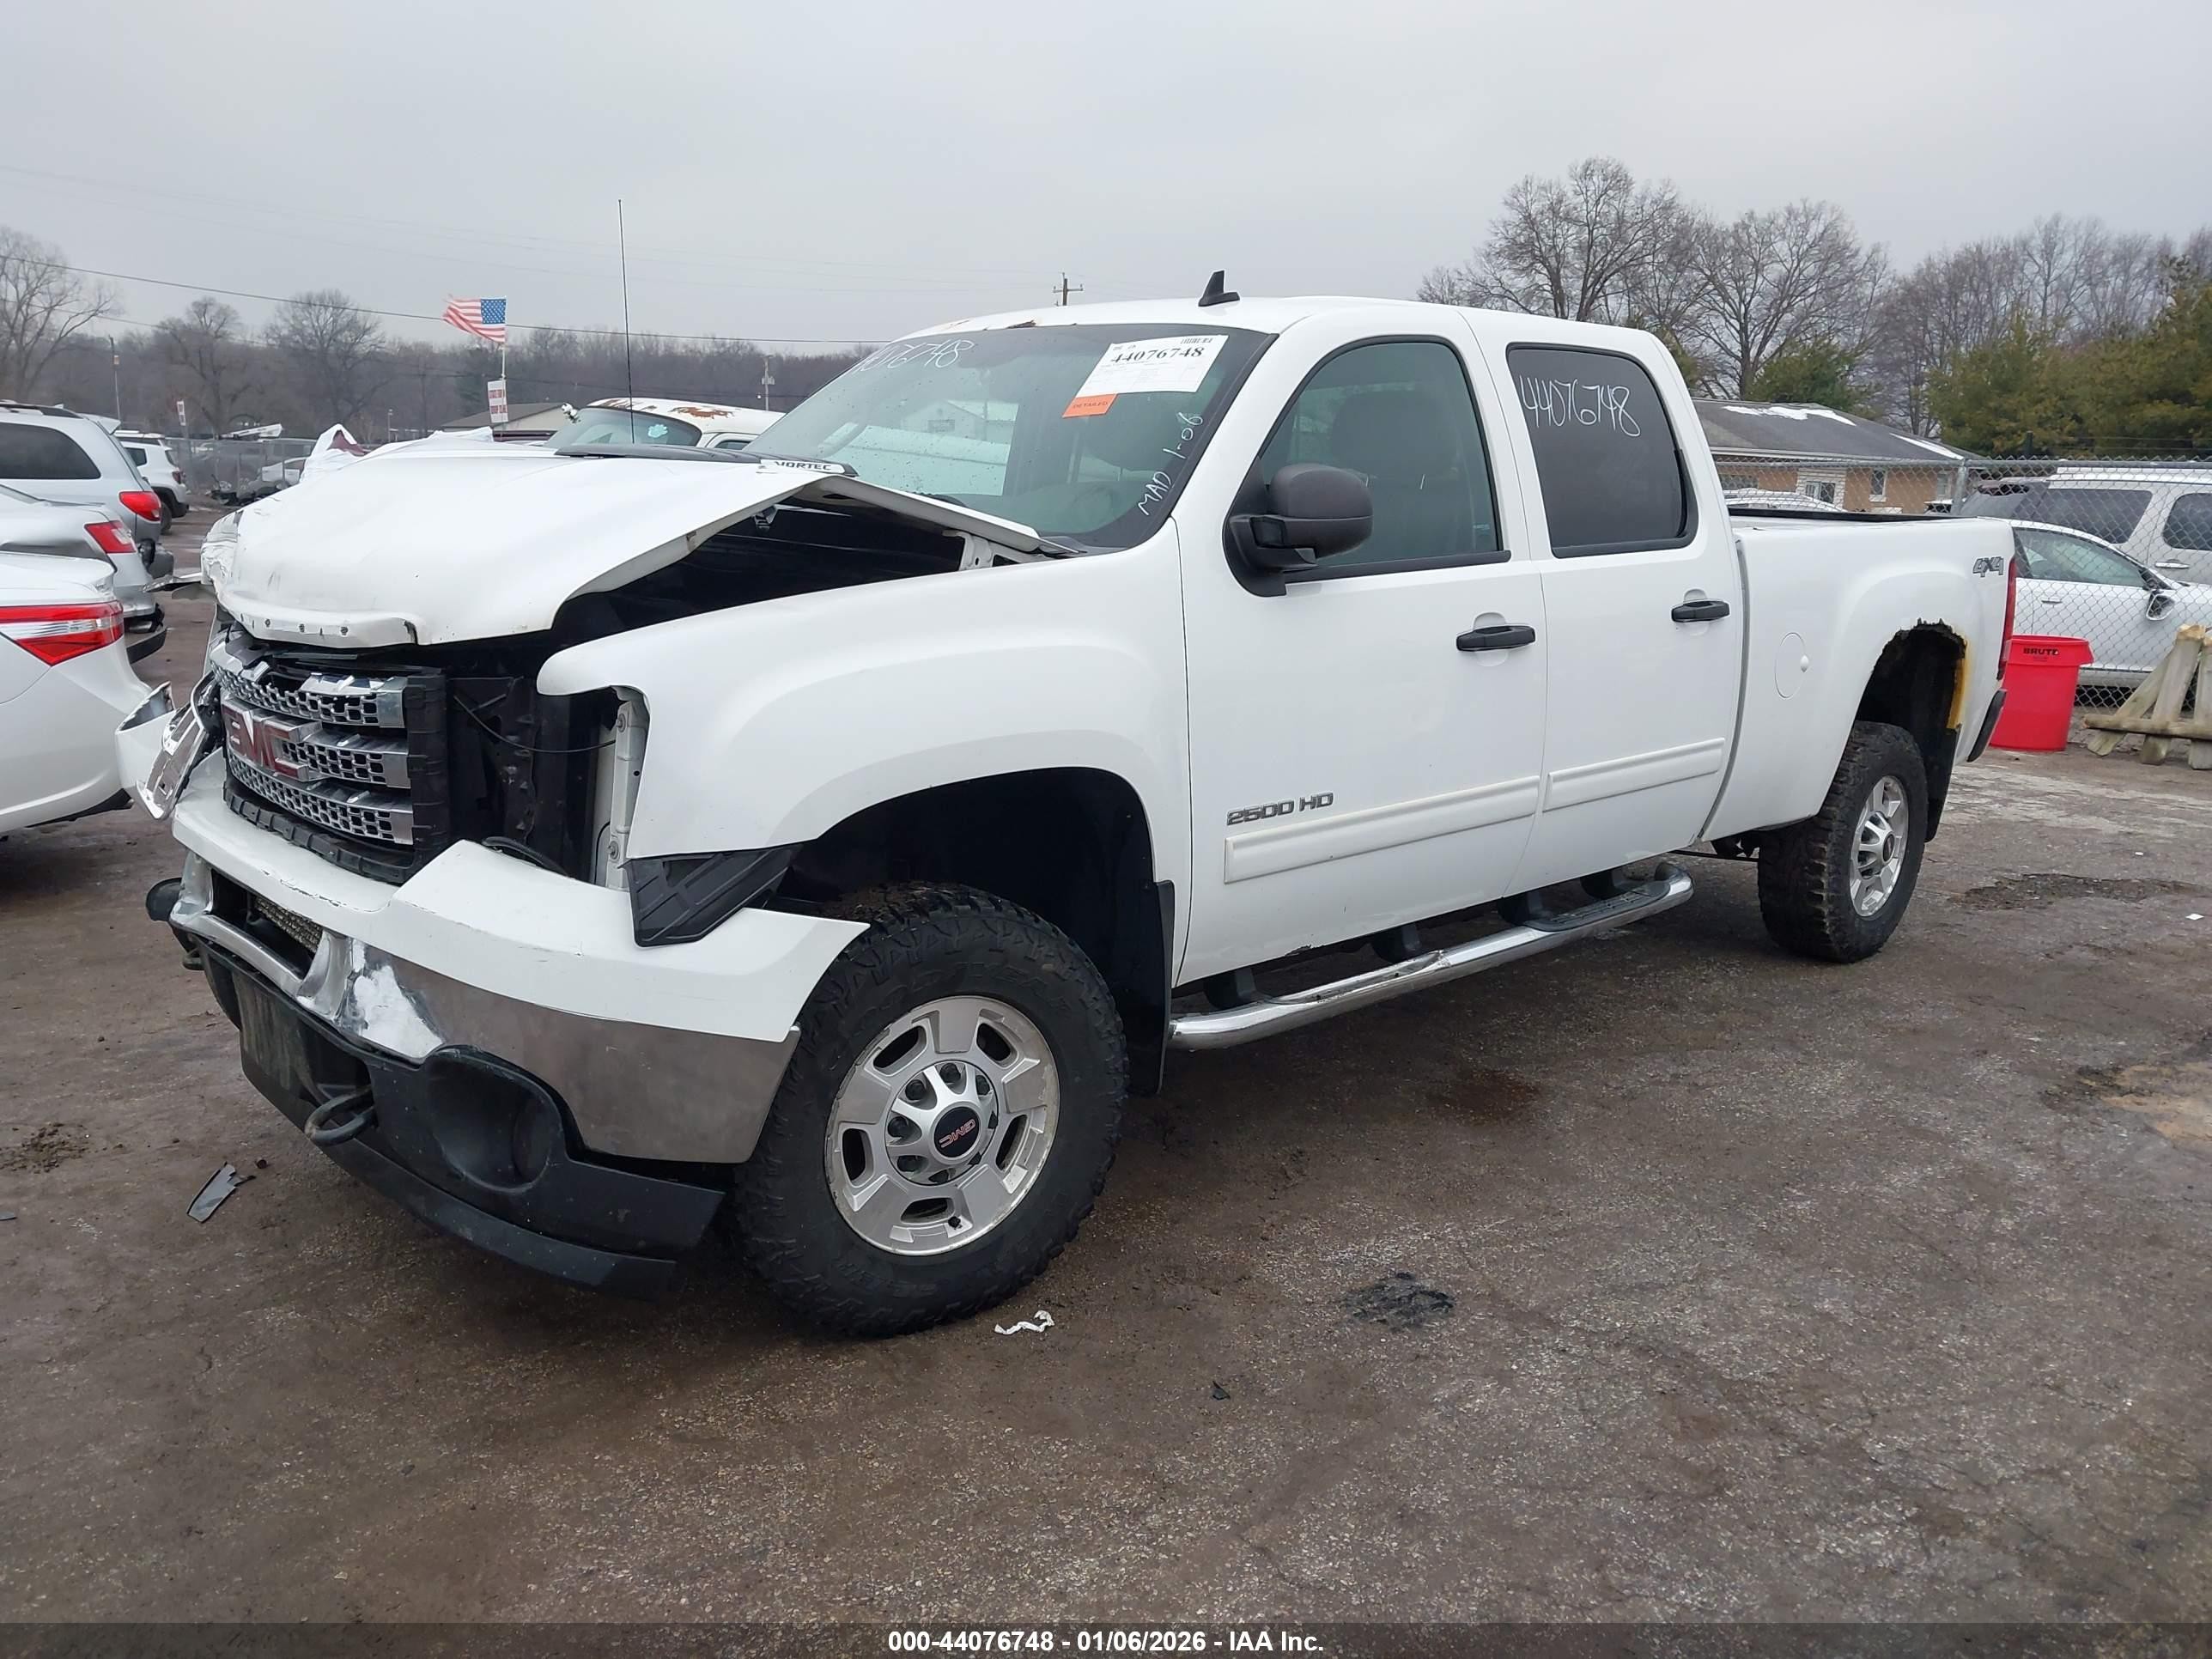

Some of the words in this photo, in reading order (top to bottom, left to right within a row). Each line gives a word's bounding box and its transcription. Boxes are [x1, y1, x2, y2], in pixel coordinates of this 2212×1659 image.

[1111, 346, 1206, 364] 44076748
[1519, 374, 1641, 437] 44076748
[774, 461, 832, 471] VORTEC
[1138, 471, 1172, 516] MAD
[1162, 411, 1204, 459] 1-06
[220, 699, 319, 783] GMC
[1226, 799, 1295, 826] 2500
[1298, 792, 1334, 811] HD
[939, 1118, 976, 1149] GMC
